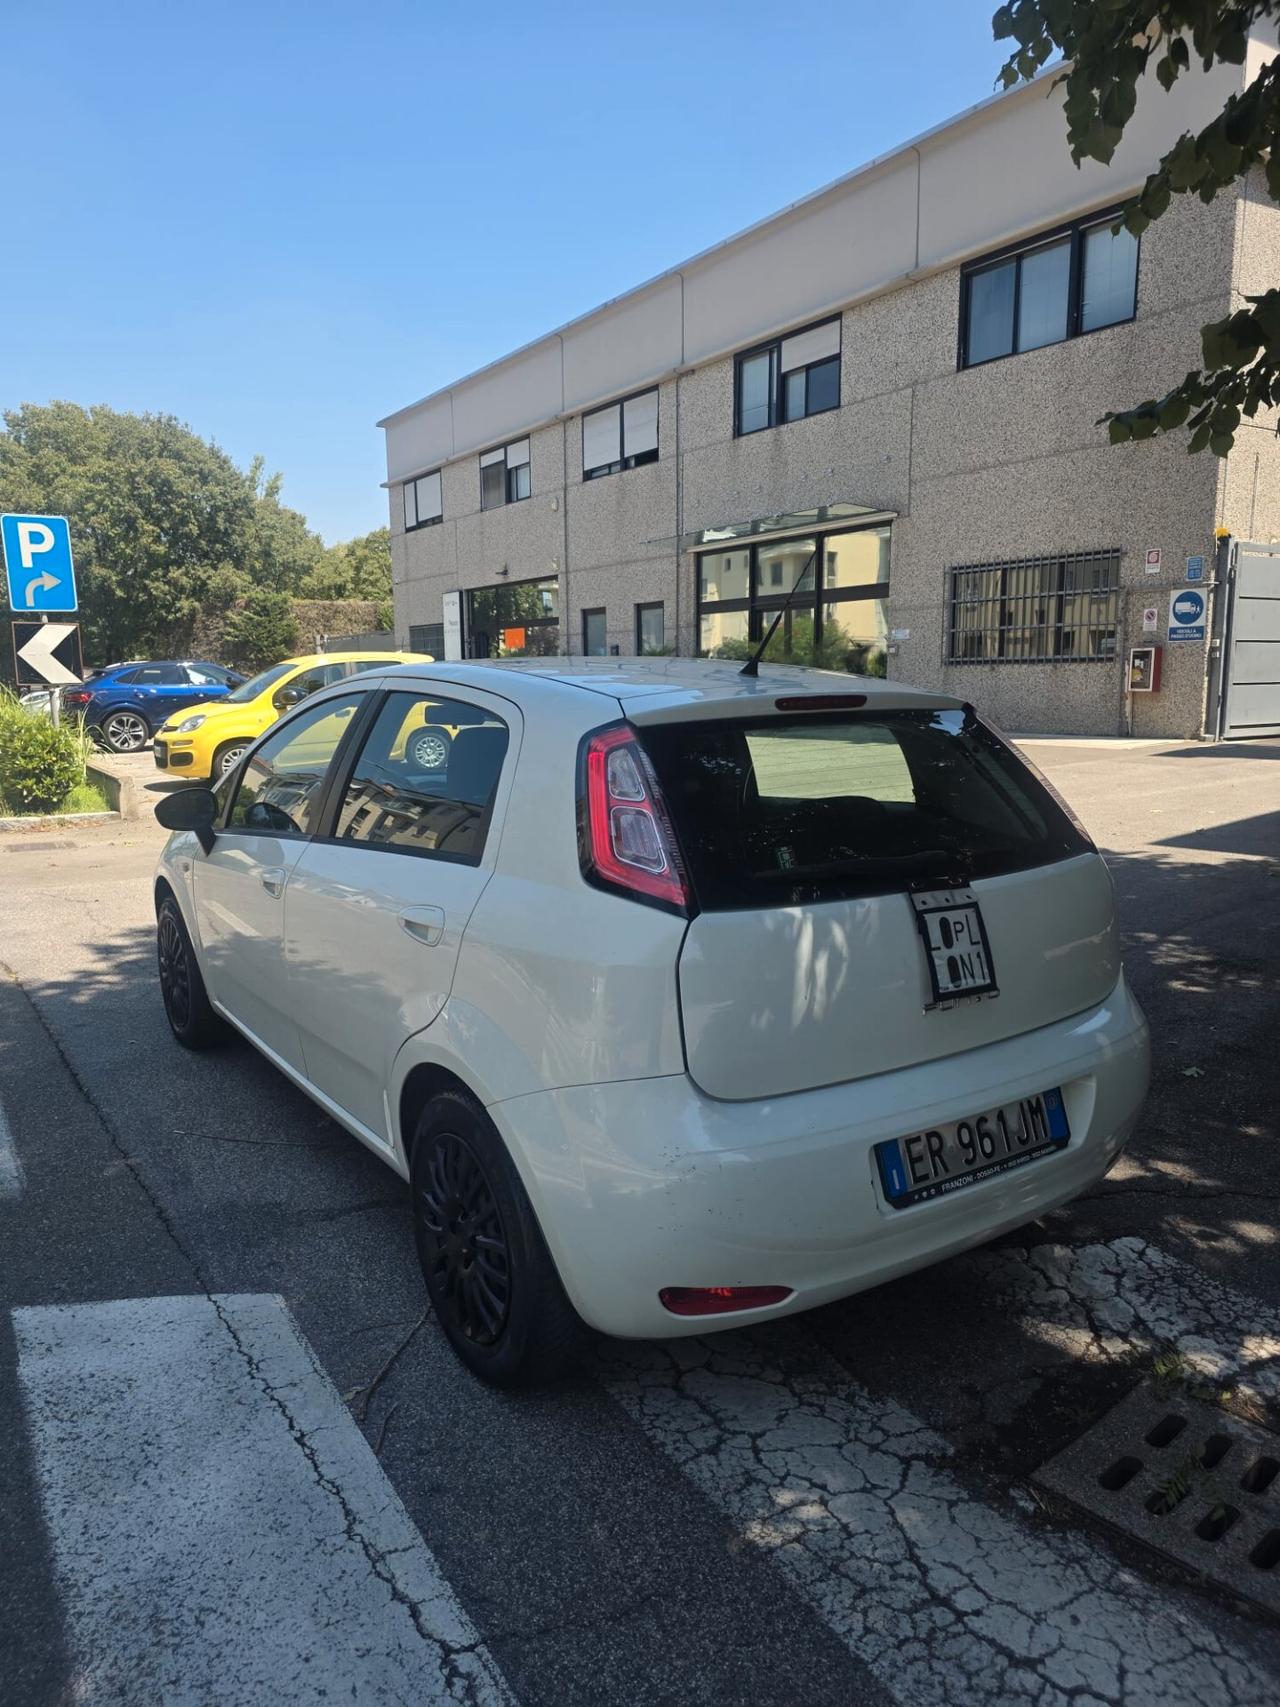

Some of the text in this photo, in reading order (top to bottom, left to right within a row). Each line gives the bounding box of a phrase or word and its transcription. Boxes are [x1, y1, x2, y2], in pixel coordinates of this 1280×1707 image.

[17, 522, 55, 568] P
[904, 1130, 949, 1185] ER
[941, 1174, 974, 1191] FRANZONI
